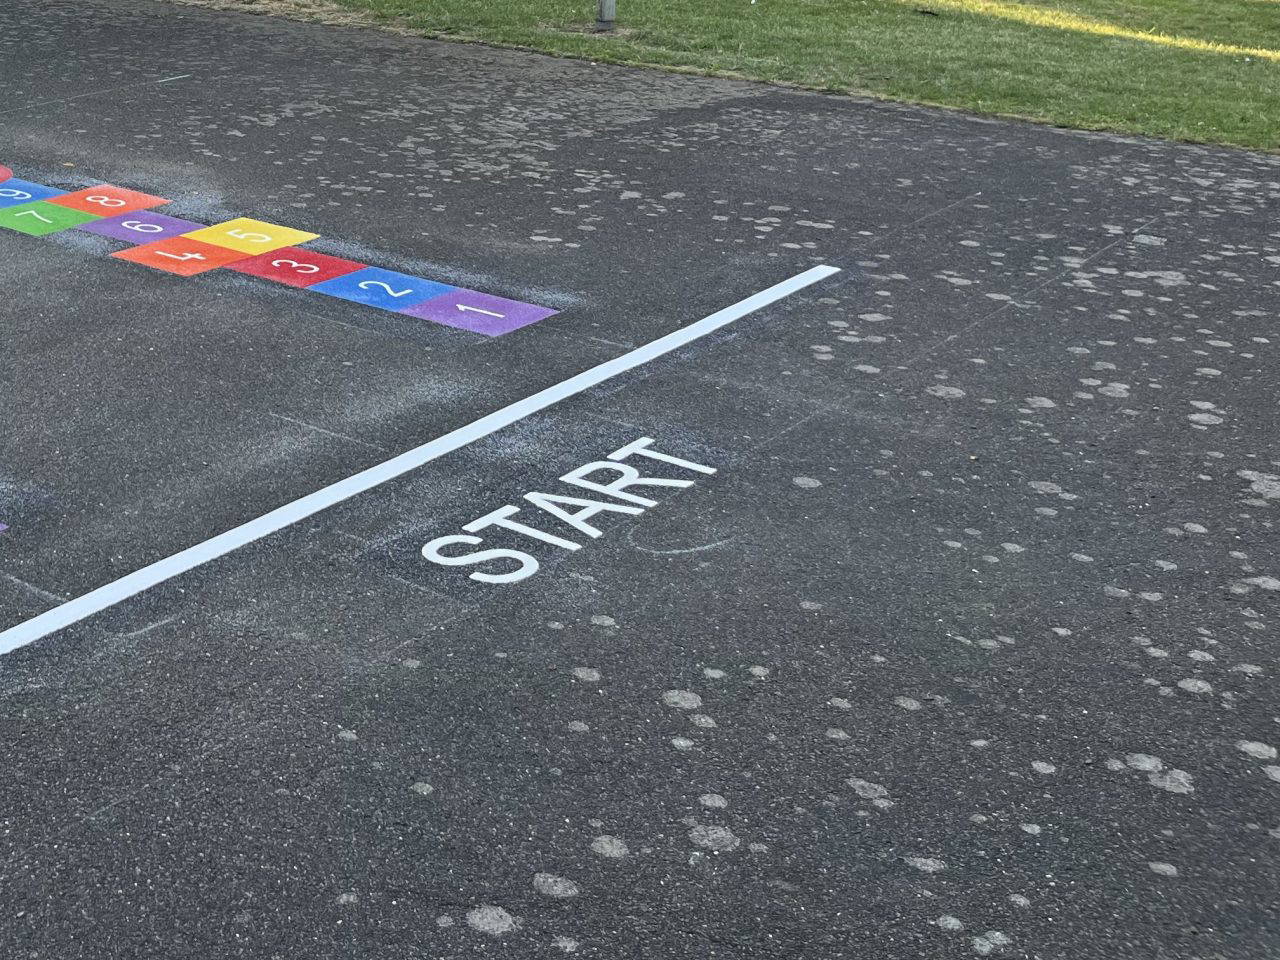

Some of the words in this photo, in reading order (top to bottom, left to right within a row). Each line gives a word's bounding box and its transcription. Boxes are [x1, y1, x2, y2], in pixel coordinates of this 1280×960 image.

[86, 195, 126, 207] 8
[14, 209, 53, 224] 7
[121, 220, 164, 233] 6
[226, 229, 273, 243] 5
[155, 250, 206, 261] 4
[271, 259, 320, 274] 3
[358, 280, 413, 298] 2
[455, 303, 505, 318] 1
[421, 436, 718, 584] START
